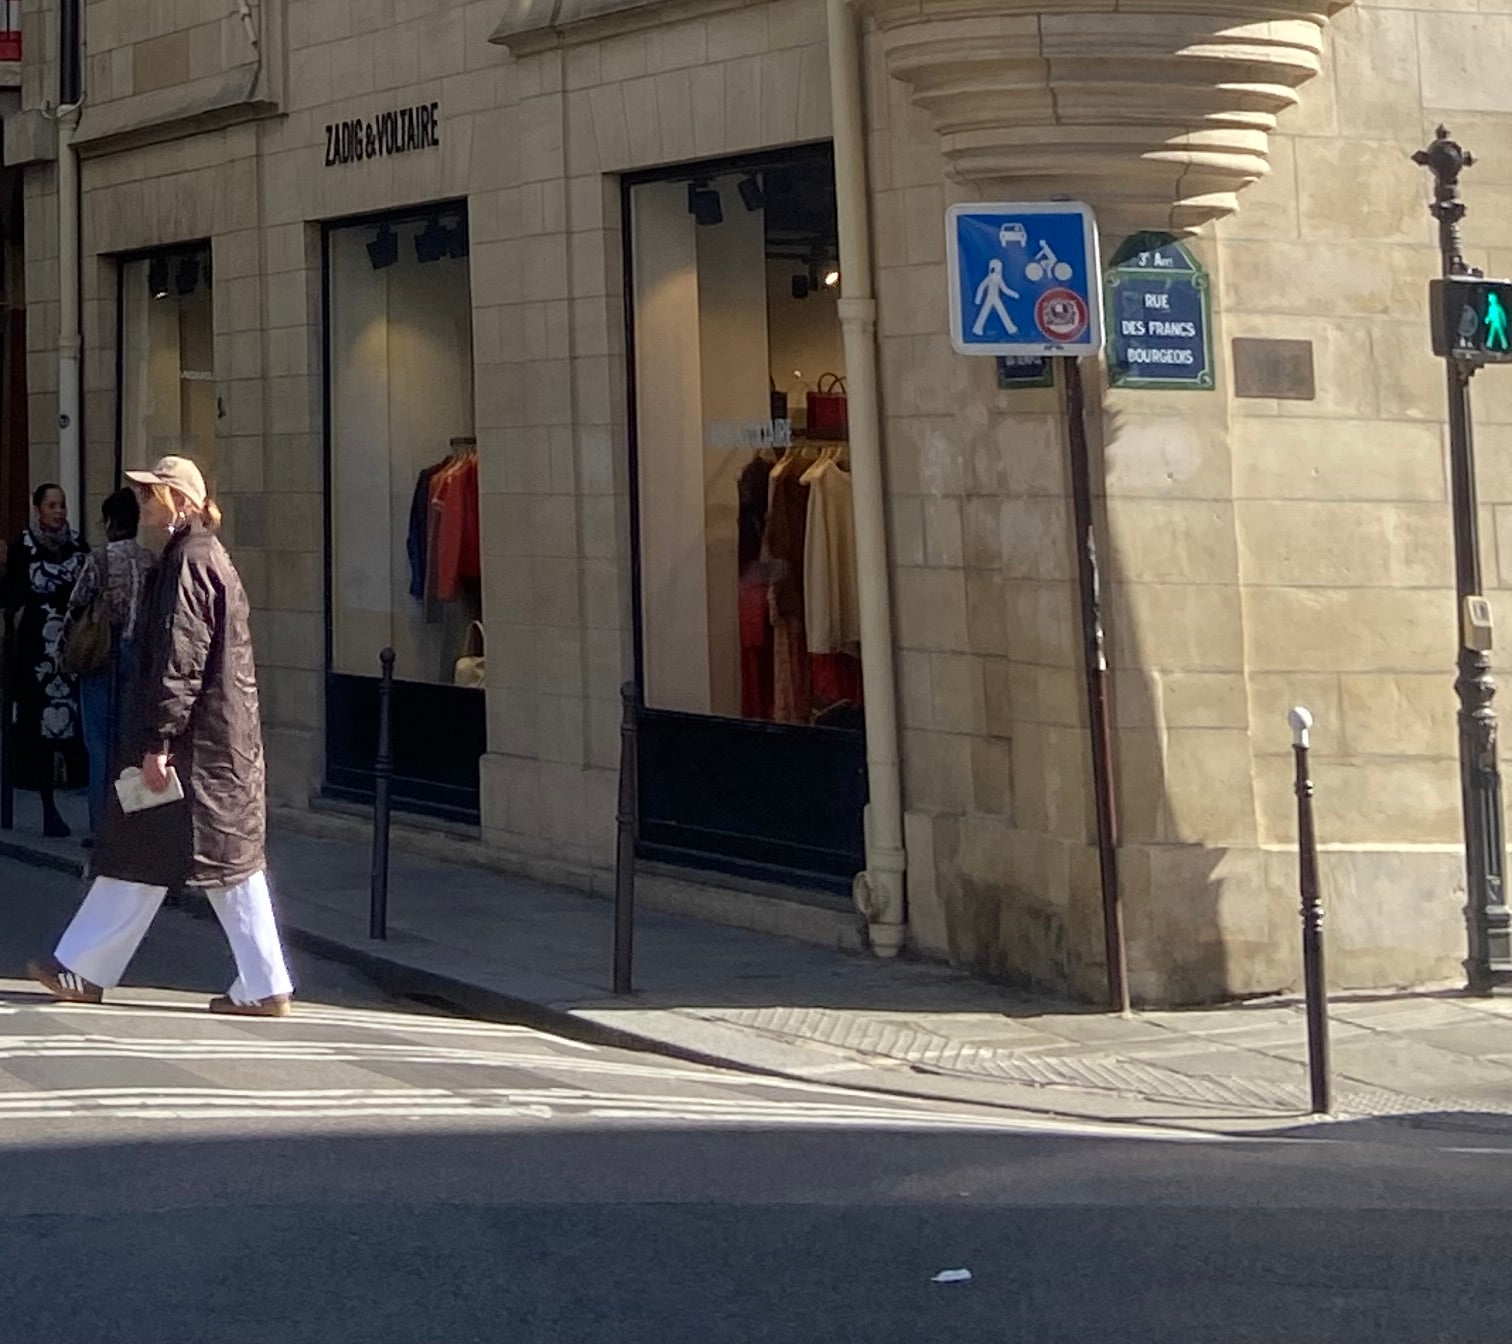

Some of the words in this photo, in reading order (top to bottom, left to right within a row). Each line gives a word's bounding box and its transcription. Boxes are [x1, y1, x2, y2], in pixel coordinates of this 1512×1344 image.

[1144, 293, 1170, 309] RUE
[1121, 320, 1146, 336] DES
[1148, 320, 1196, 338] FRANCS
[1127, 348, 1194, 365] BOURGEOIS
